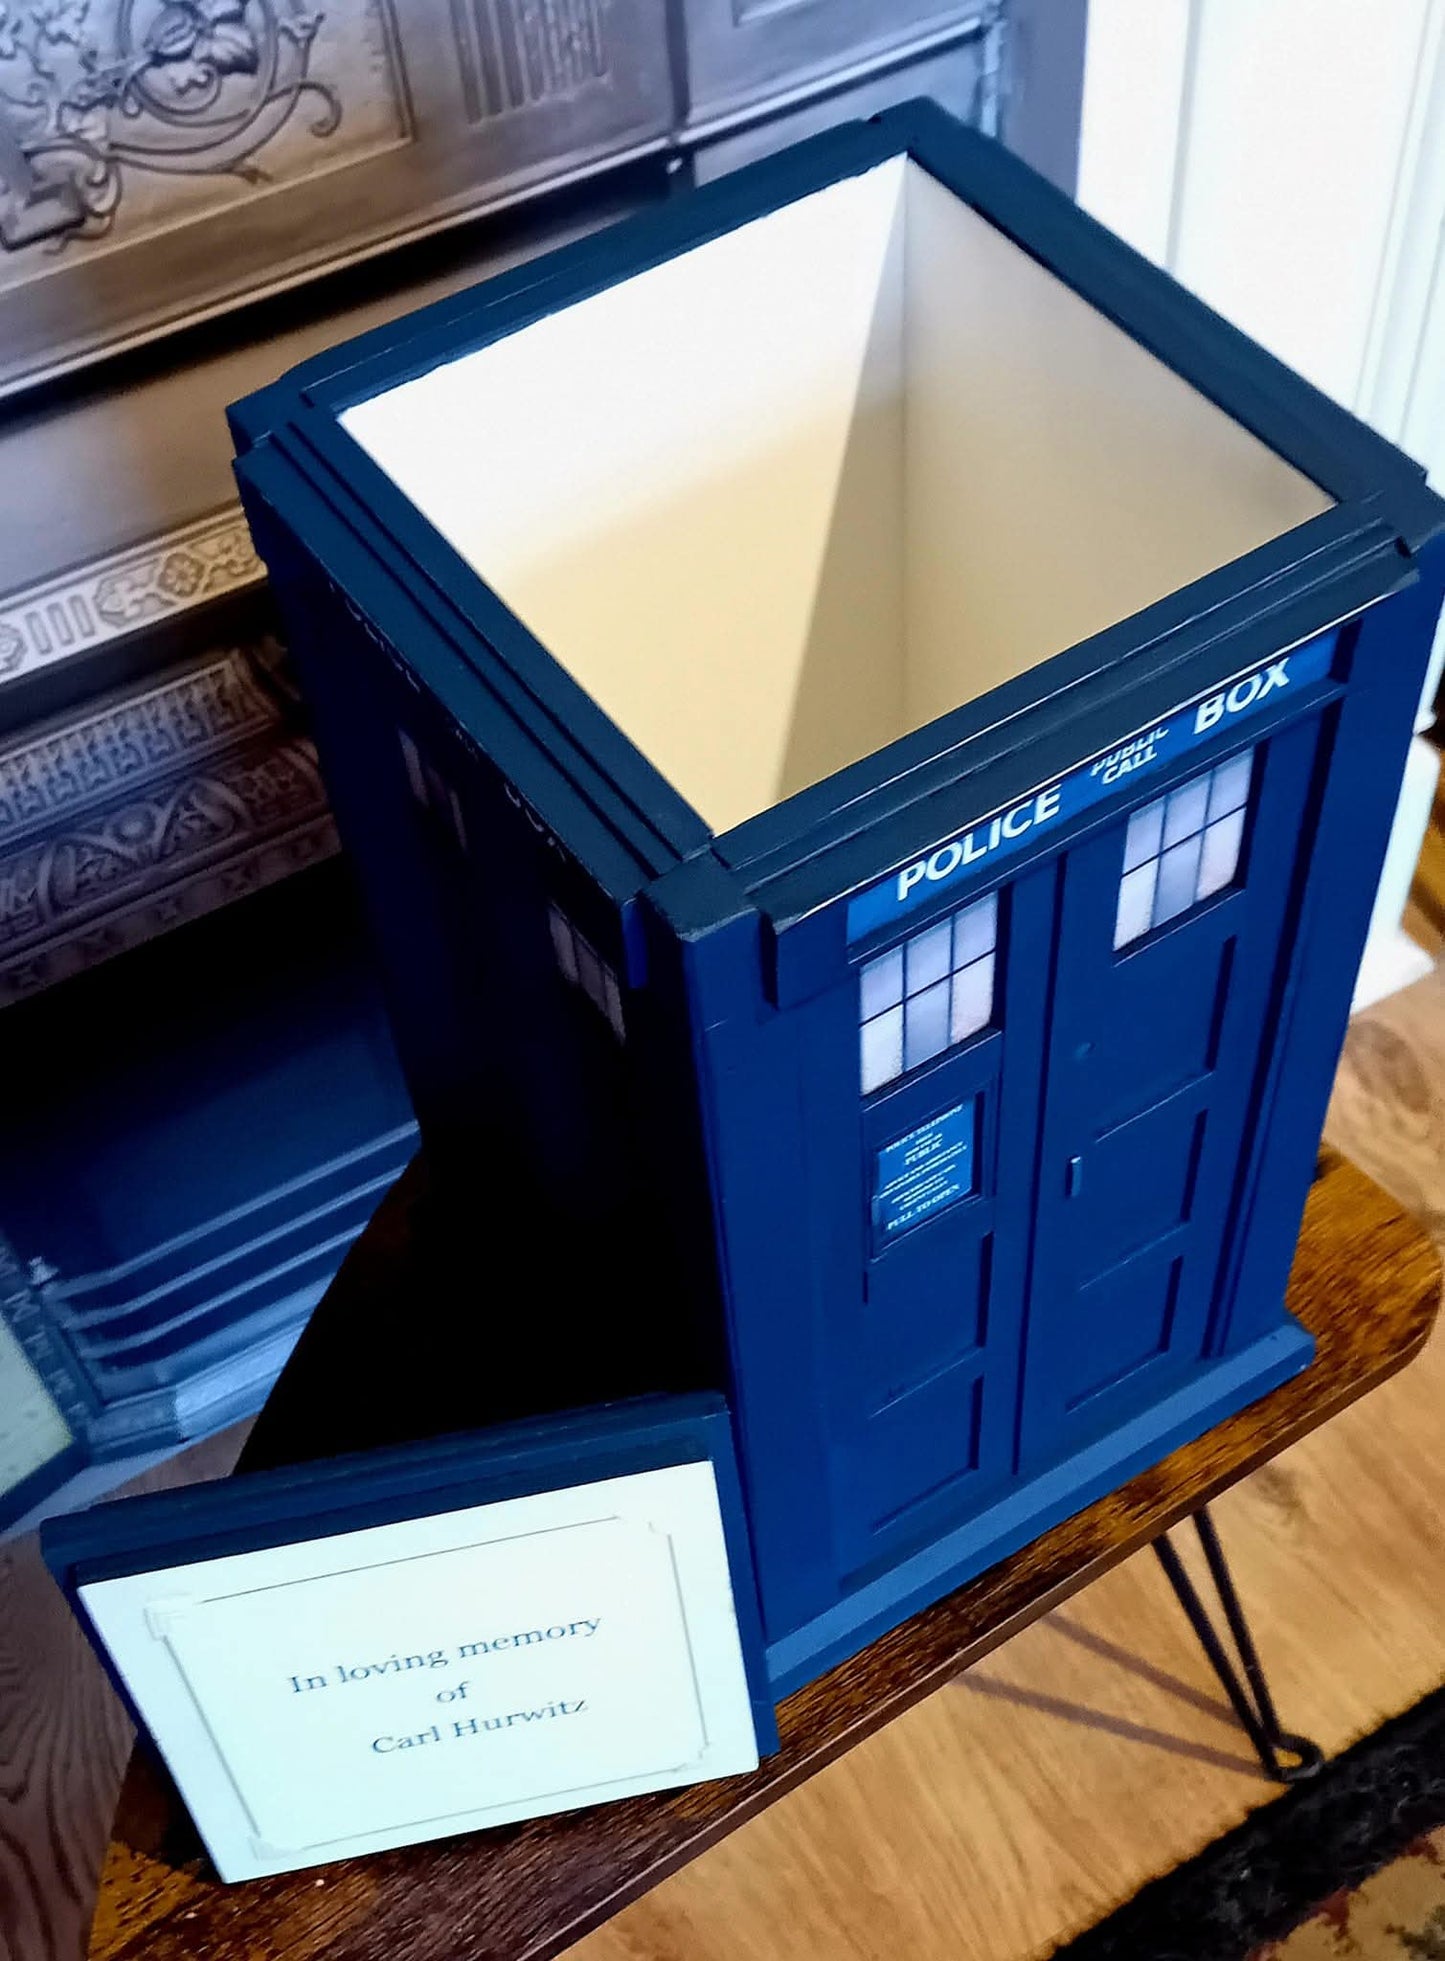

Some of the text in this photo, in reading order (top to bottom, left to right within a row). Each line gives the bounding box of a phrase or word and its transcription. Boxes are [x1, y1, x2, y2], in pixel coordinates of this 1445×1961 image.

[1193, 658, 1290, 734] BOX
[1102, 745, 1157, 785] CALL
[897, 784, 1062, 901] POLICE
[288, 1617, 601, 1694] In loving memory
[436, 1681, 472, 1702] of
[371, 1700, 589, 1753] Carl Hurwitz
